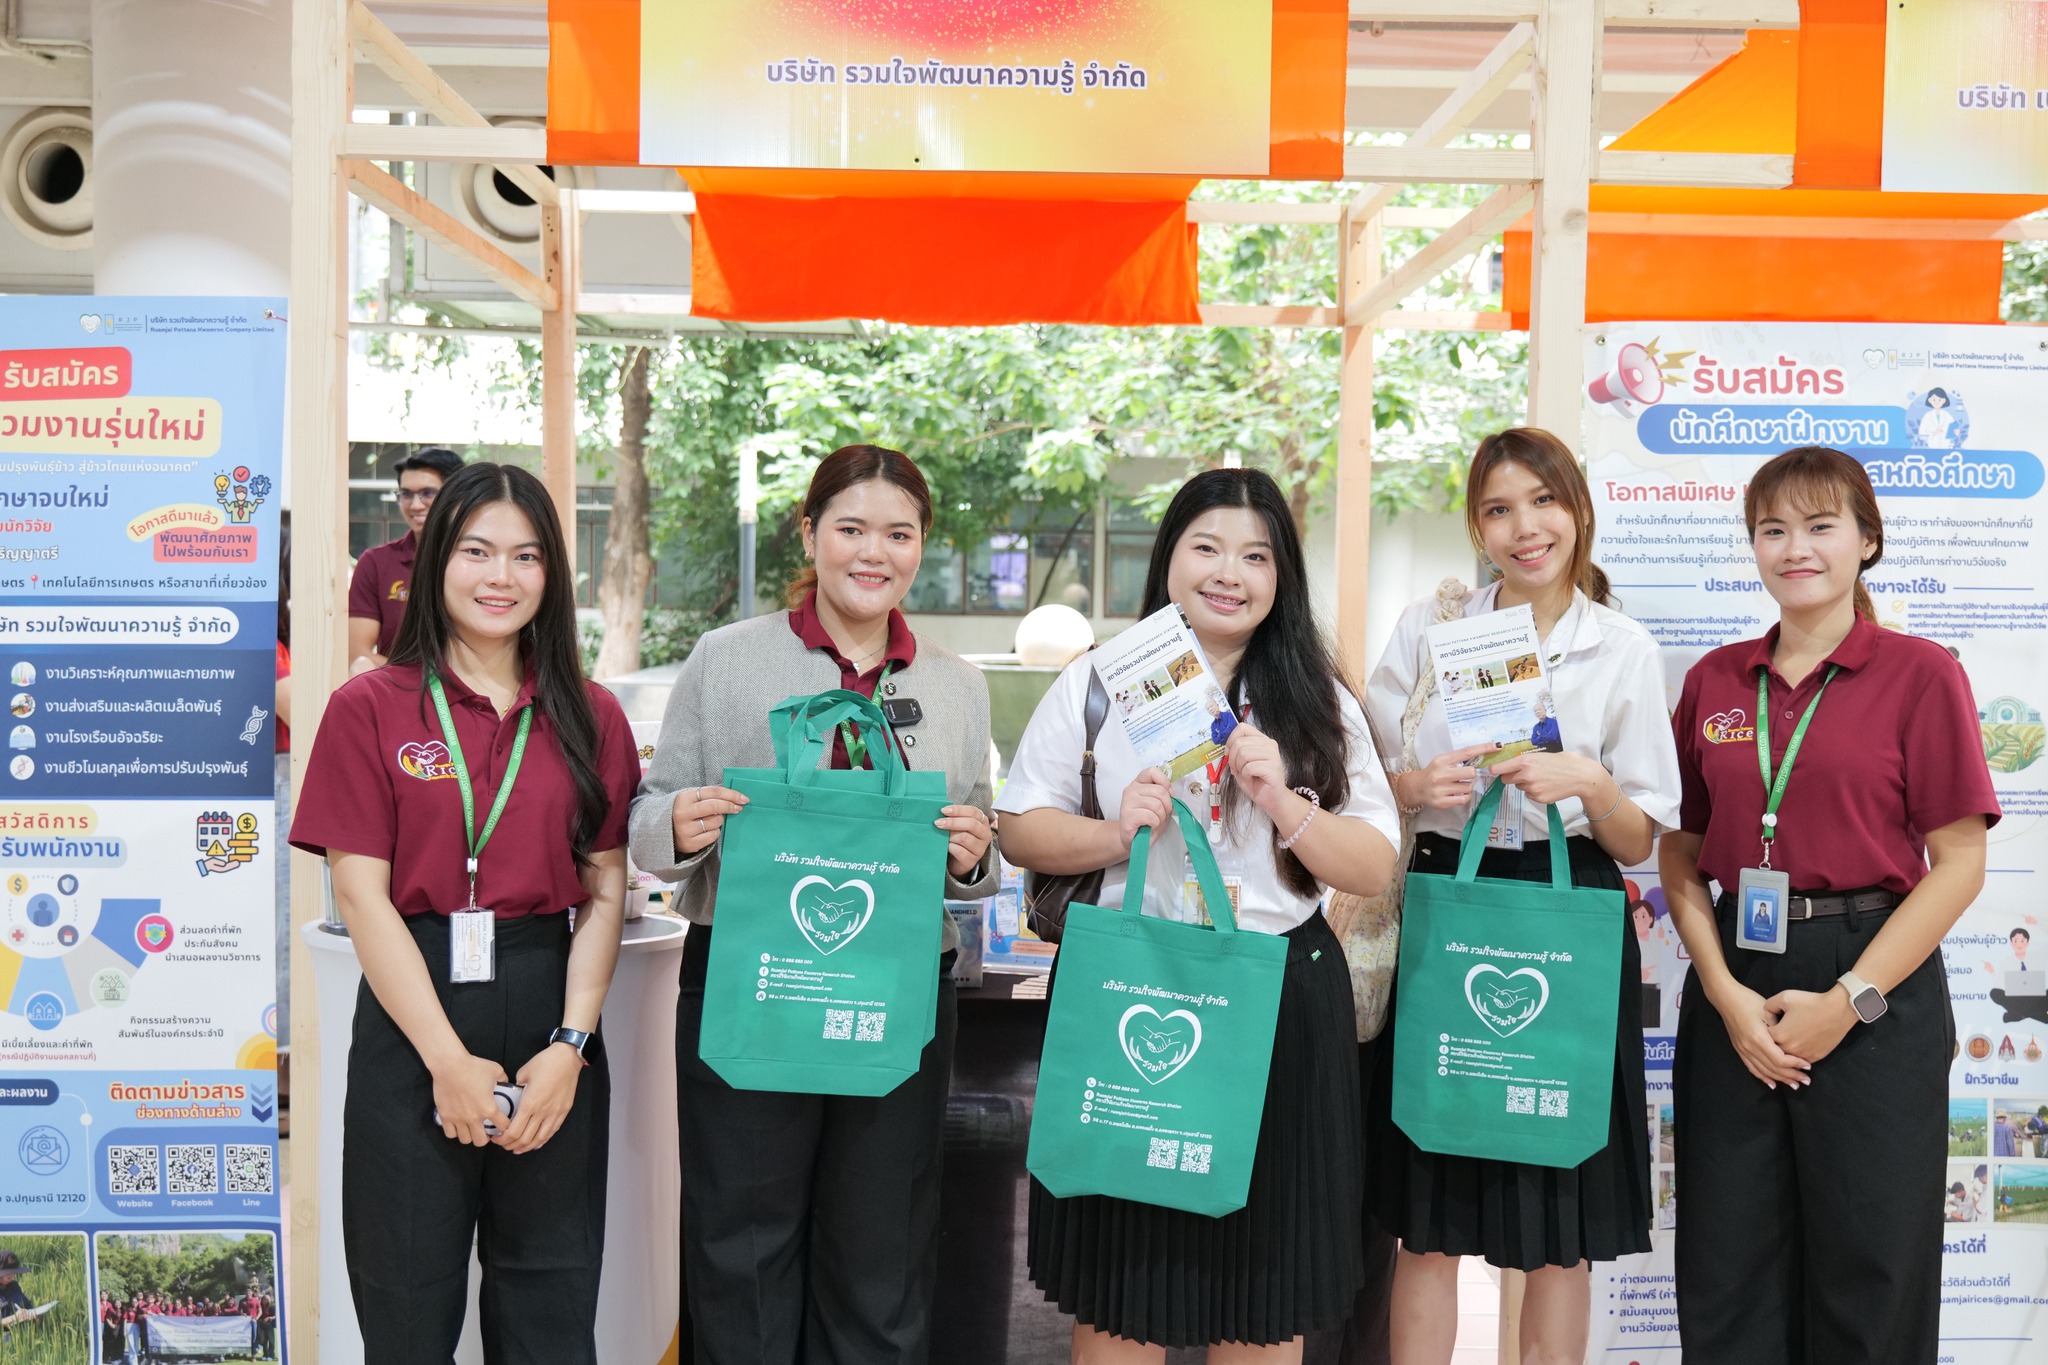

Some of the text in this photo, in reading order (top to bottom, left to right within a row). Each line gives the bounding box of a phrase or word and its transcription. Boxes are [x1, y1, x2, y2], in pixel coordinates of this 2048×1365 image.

[767, 58, 1147, 94] บริษัท รวมใจพัฒนาความรู้ จำกัด
[1958, 84, 2026, 109] บริษัท
[4, 359, 119, 388] รับสมัคร
[1693, 355, 1844, 395] รับสมัคร
[1, 407, 206, 449] วมงานรุ่นใหม่
[1670, 408, 1889, 445] นักศึกษาฝึกงาน
[1864, 452, 2015, 489] สหกิจศึกษา
[1606, 481, 1736, 502] โอกาสพิเศษ
[130, 508, 219, 537] โอกาสดีมาแล้ว
[1920, 515, 2033, 529] เรากำลังมองหานักศึกษาที่มี
[160, 531, 252, 544] พัฒนาศักยภาพ
[1601, 531, 1733, 548] ความตั้งใจและรักในการเรียนรู้
[1948, 533, 2029, 548] เพื่อพัฒนาศักยภาพ
[163, 545, 249, 559] ไปพร้อมกับเรา
[42, 576, 155, 588] เทคโนโลยีการเกษตร
[158, 574, 268, 589] หรือสาขาที่เกี่ยวข้อง
[26, 615, 183, 638] รวมใจพัฒนาความรู้
[188, 616, 232, 633] จำกัด
[46, 666, 236, 682] งานวิเคราะห์คุณภาพและกายภาพ
[45, 699, 222, 716] งานส่งเสริมและผลิตเมล็ดพันธุ์
[46, 730, 163, 744] งานโรงเรือนอัจฉริยะ
[44, 757, 249, 778] งานชีวโมเลกุลเพื่อการปรับปรุงพันธุ์
[0, 811, 89, 829] สวัสดิการ
[1, 836, 121, 858] รับพนักงาน
[774, 852, 900, 875] บริษัท รวมใจพัฒนาความรู้ จำกัด
[179, 924, 242, 935] ส่วนลดค่าที่พัก
[184, 938, 239, 948] ประกันสังคม
[165, 952, 261, 963] นำเสนอผลงานวิชาการ
[1446, 942, 1573, 964] บริษัท รวมใจพัฒนาความรู้ จำกัด
[1103, 979, 1229, 1007] บริษัท รวมใจพัฒนาความรู้ จำกัด
[130, 1015, 211, 1026] กิจกรรมสร้างความ
[118, 1027, 224, 1039] สัมพันธ์ในองค์กรประจำปี
[1, 1036, 93, 1049] มีเบี้ยเลี้ยงและค่าที่พัก
[1964, 1072, 2019, 1086] ฝึกวิชาชีพ
[110, 1080, 245, 1101] ติดตามข่าวสาร
[136, 1103, 241, 1119] ช่องทางด้านล่าง
[6, 1193, 86, 1205] จ.ปทุมธานี 12120
[117, 1200, 153, 1208] Website
[171, 1199, 214, 1207] Facebook
[242, 1199, 261, 1207] Line
[1619, 1285, 1657, 1301] ที่พักฟรี
